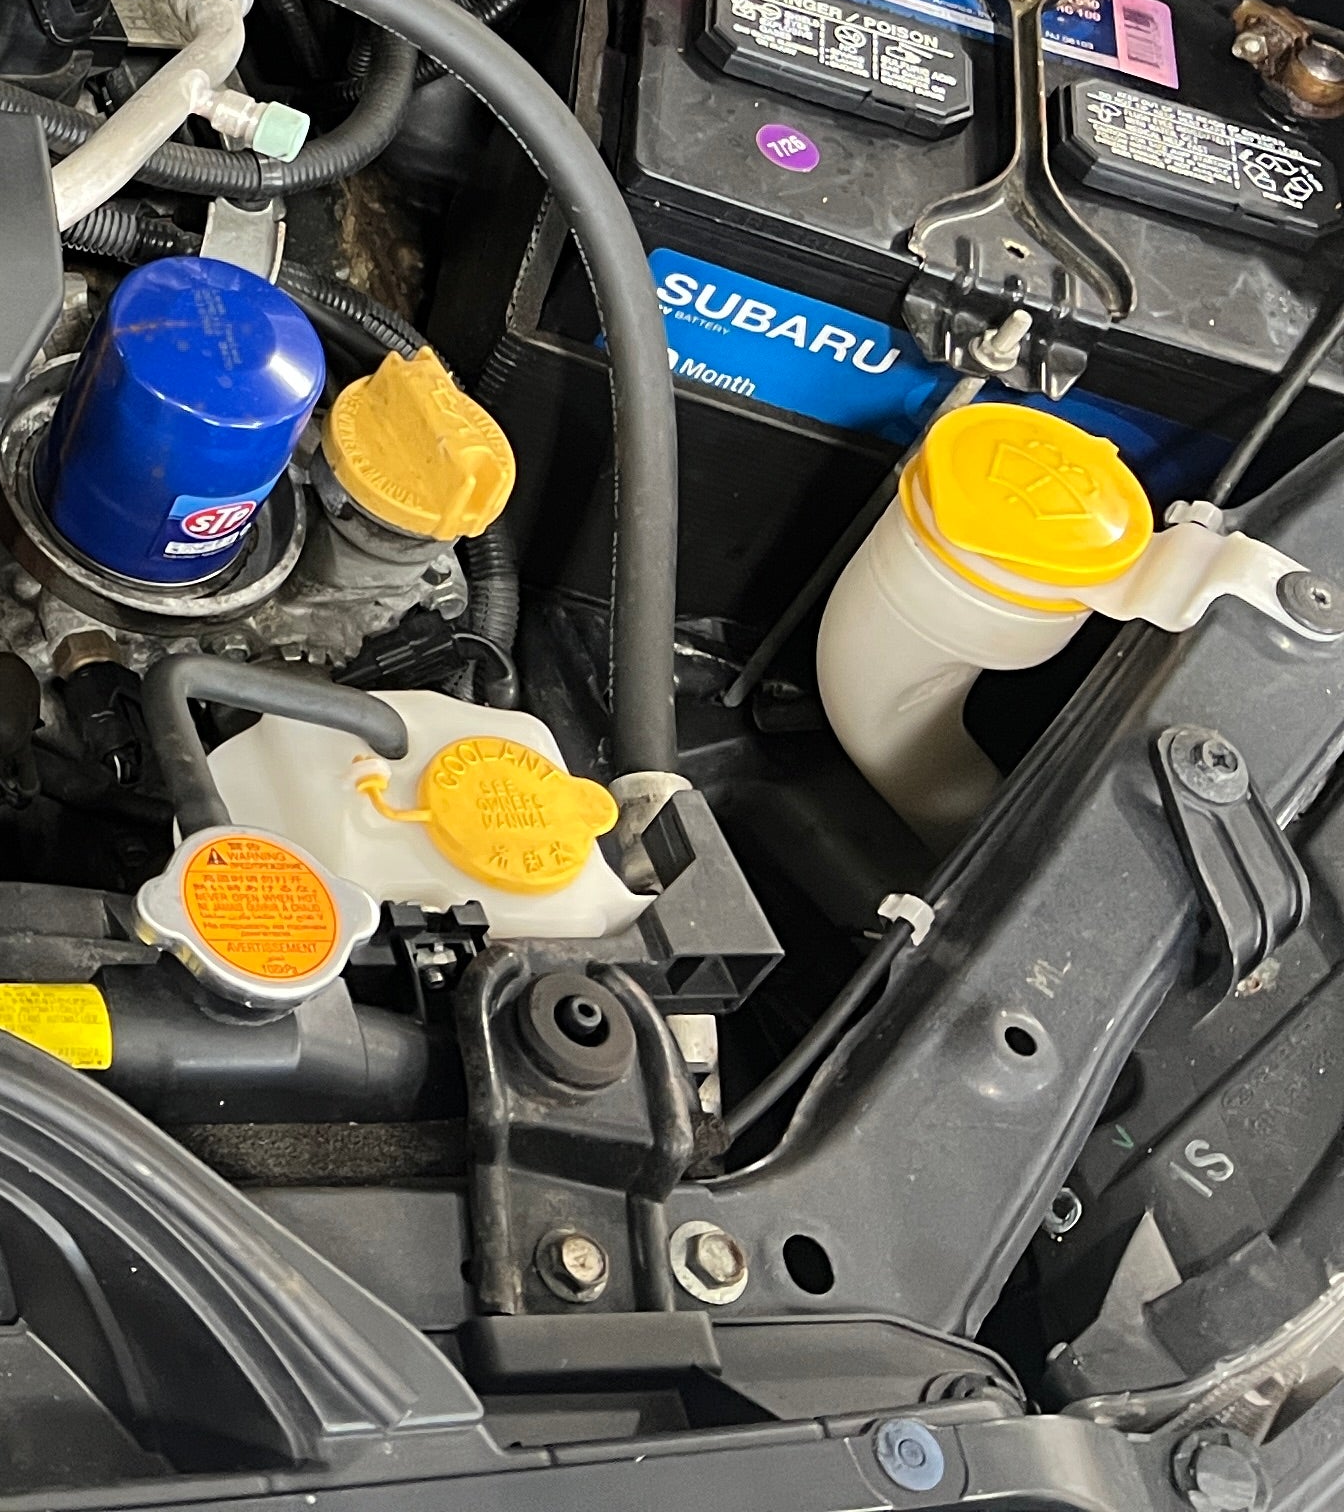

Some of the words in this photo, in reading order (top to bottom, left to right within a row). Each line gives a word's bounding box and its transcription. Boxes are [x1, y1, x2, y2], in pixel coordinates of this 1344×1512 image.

[863, 16, 939, 49] POISON
[767, 135, 806, 157] 7/26
[656, 272, 901, 374] SUBARU
[674, 310, 730, 336] BATTERY
[678, 356, 757, 398] Month
[188, 505, 250, 535] STP
[433, 741, 561, 789] COOLANT
[226, 851, 286, 861] WARNING
[195, 893, 227, 902] NEVER
[232, 893, 259, 902] OPEN
[263, 894, 293, 903] WHEN
[298, 894, 318, 903] HOT
[227, 942, 317, 953] AVERTISSEMENT
